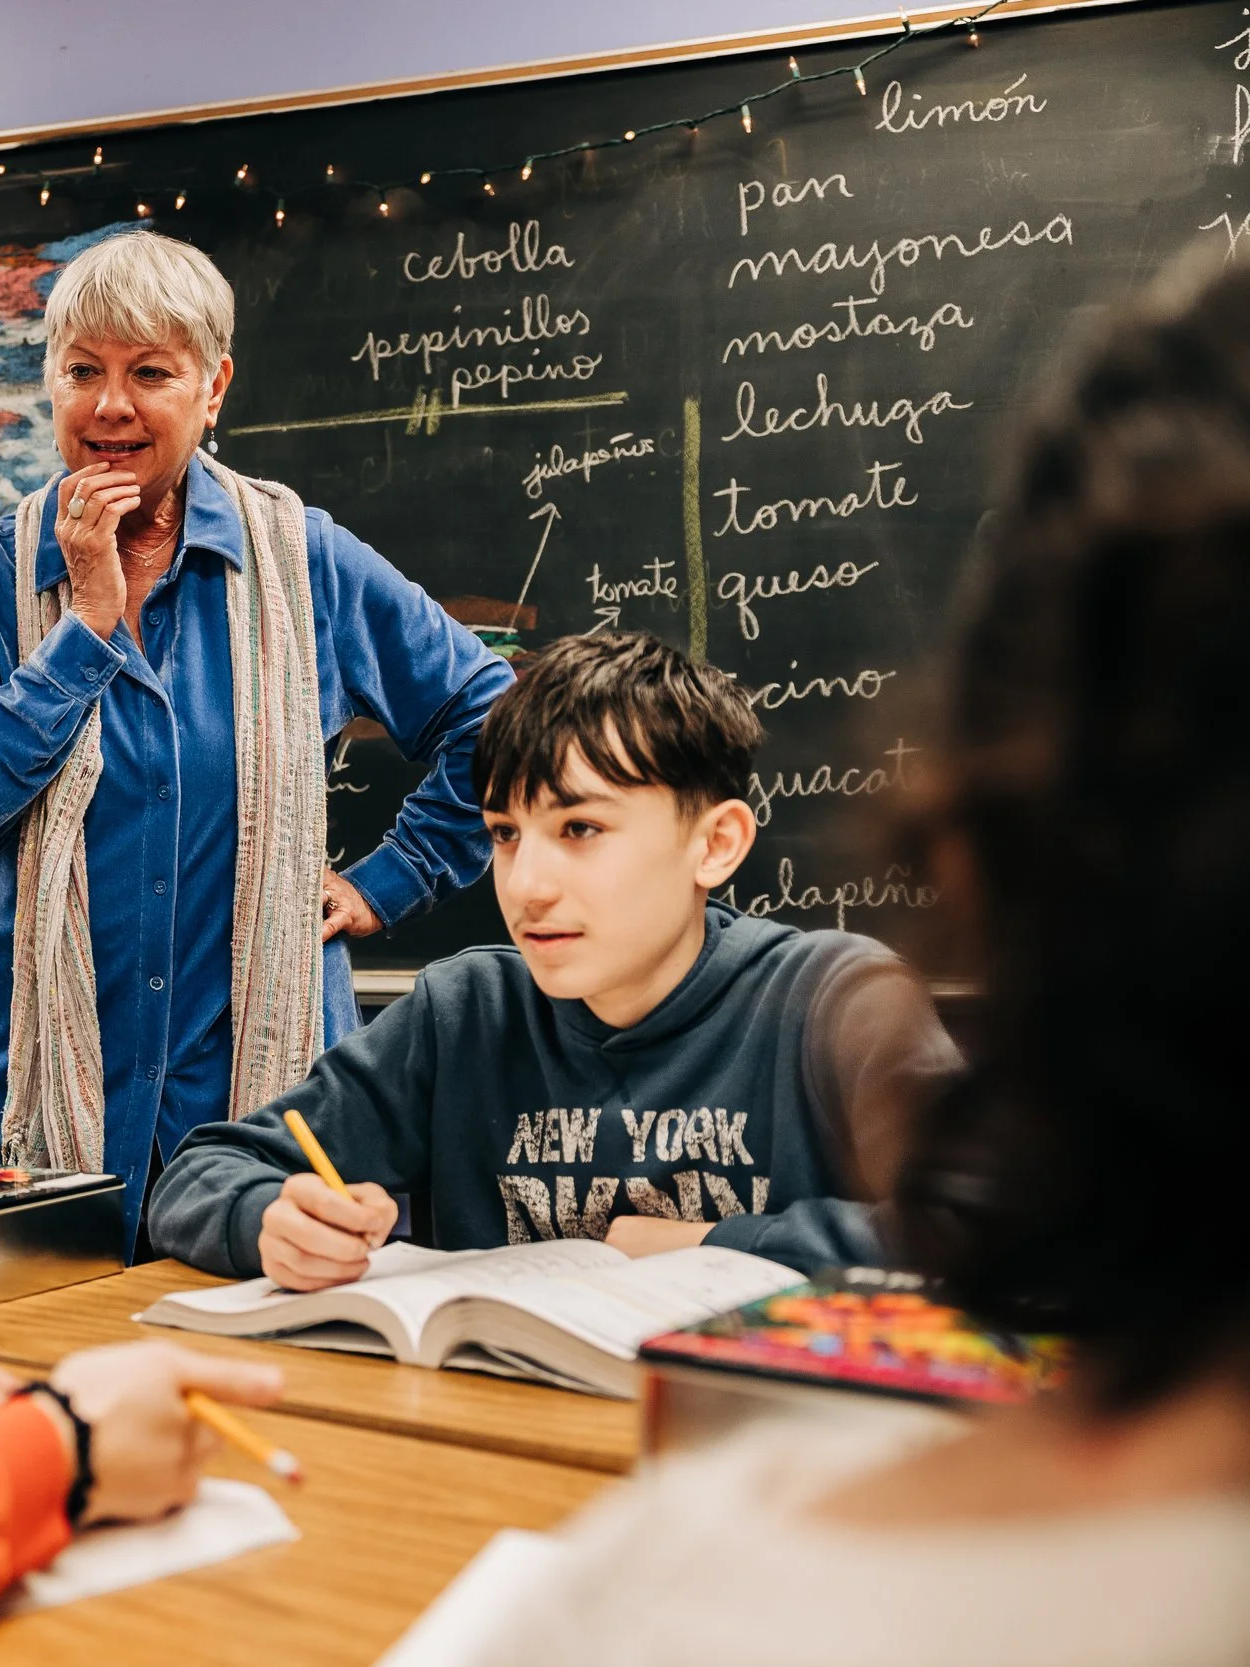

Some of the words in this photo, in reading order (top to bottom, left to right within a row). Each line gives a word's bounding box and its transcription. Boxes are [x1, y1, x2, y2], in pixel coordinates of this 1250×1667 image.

[875, 73, 1048, 133] limón
[738, 173, 854, 236] pan
[403, 219, 575, 283] cebolla
[727, 212, 1073, 294] mayonesa
[350, 292, 591, 381] pepinillos
[721, 295, 975, 364] mostaza
[451, 348, 603, 408] pepino
[721, 372, 974, 444] lechuga
[713, 460, 919, 537] tomate
[585, 556, 678, 604] tomate
[717, 560, 880, 641] queso
[722, 659, 897, 710] cino
[748, 737, 922, 827] guacat
[506, 1107, 602, 1165] NEW
[621, 1106, 755, 1166] YORK
